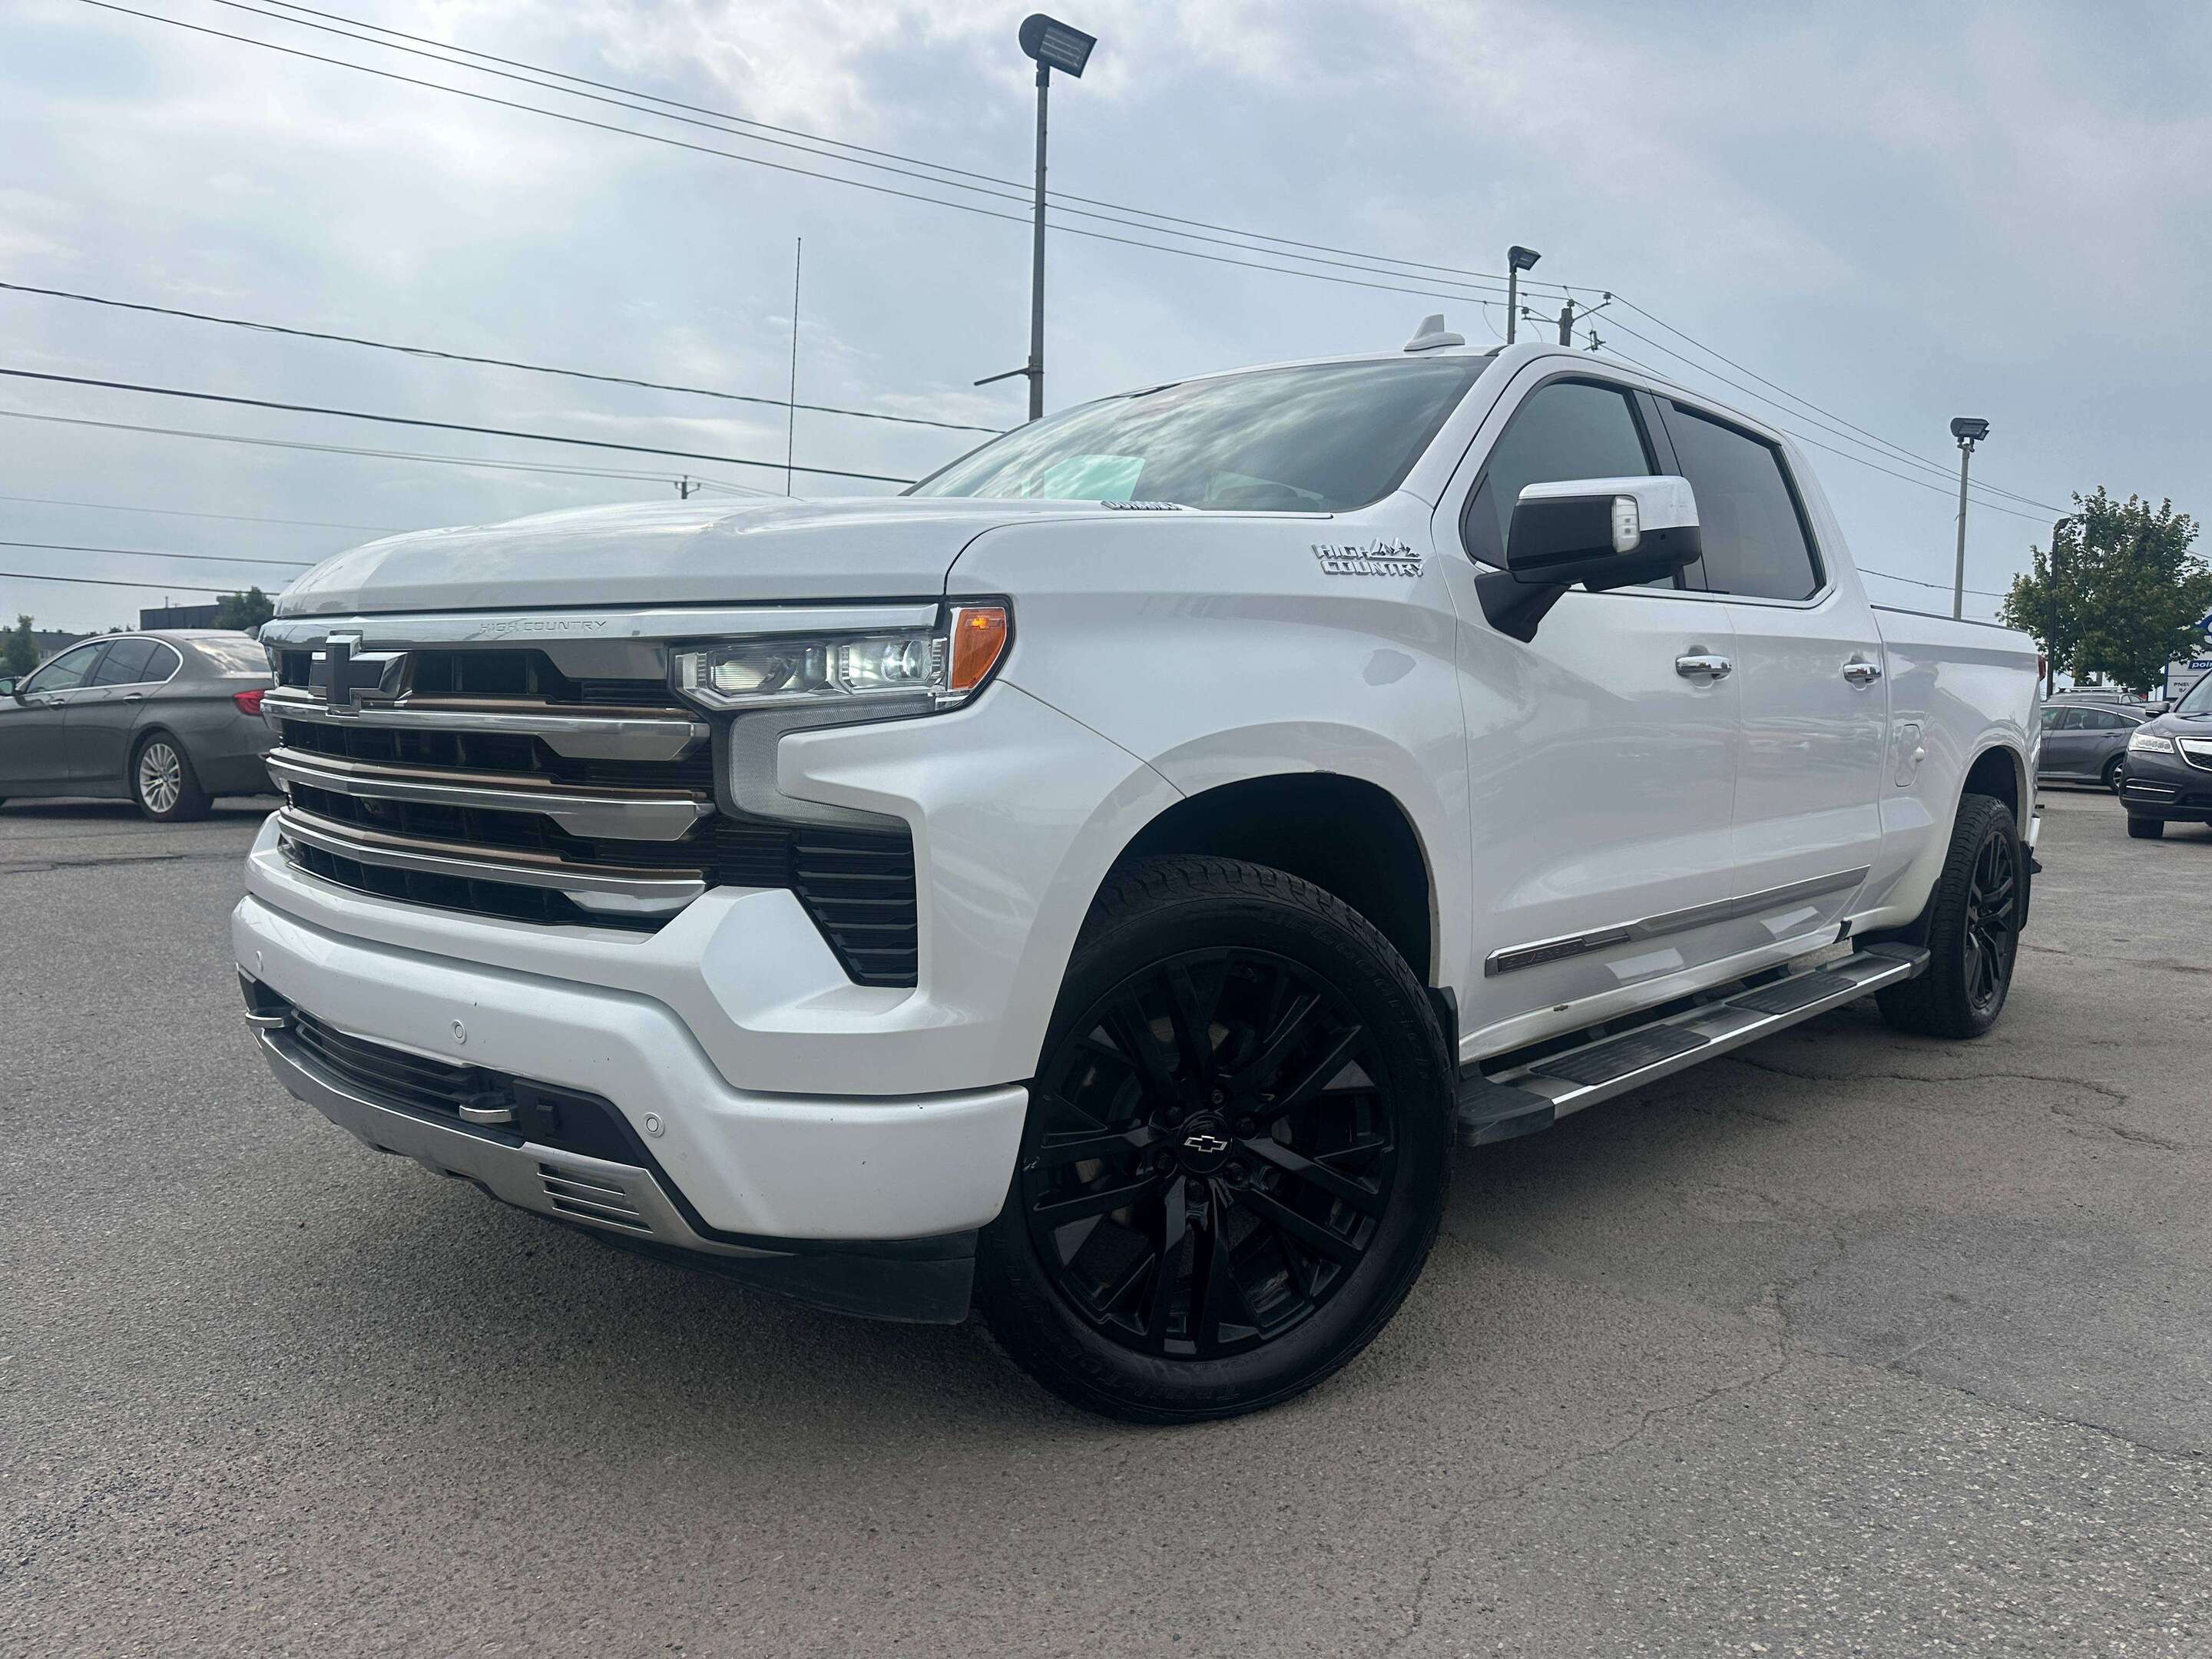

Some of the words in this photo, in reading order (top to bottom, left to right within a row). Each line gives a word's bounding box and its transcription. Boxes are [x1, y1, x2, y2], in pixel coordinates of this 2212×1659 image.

[1311, 544, 1373, 560] HIGH
[1320, 560, 1424, 577] COUNTRY
[479, 622, 518, 632] HIGH
[524, 620, 607, 631] COUNTRY
